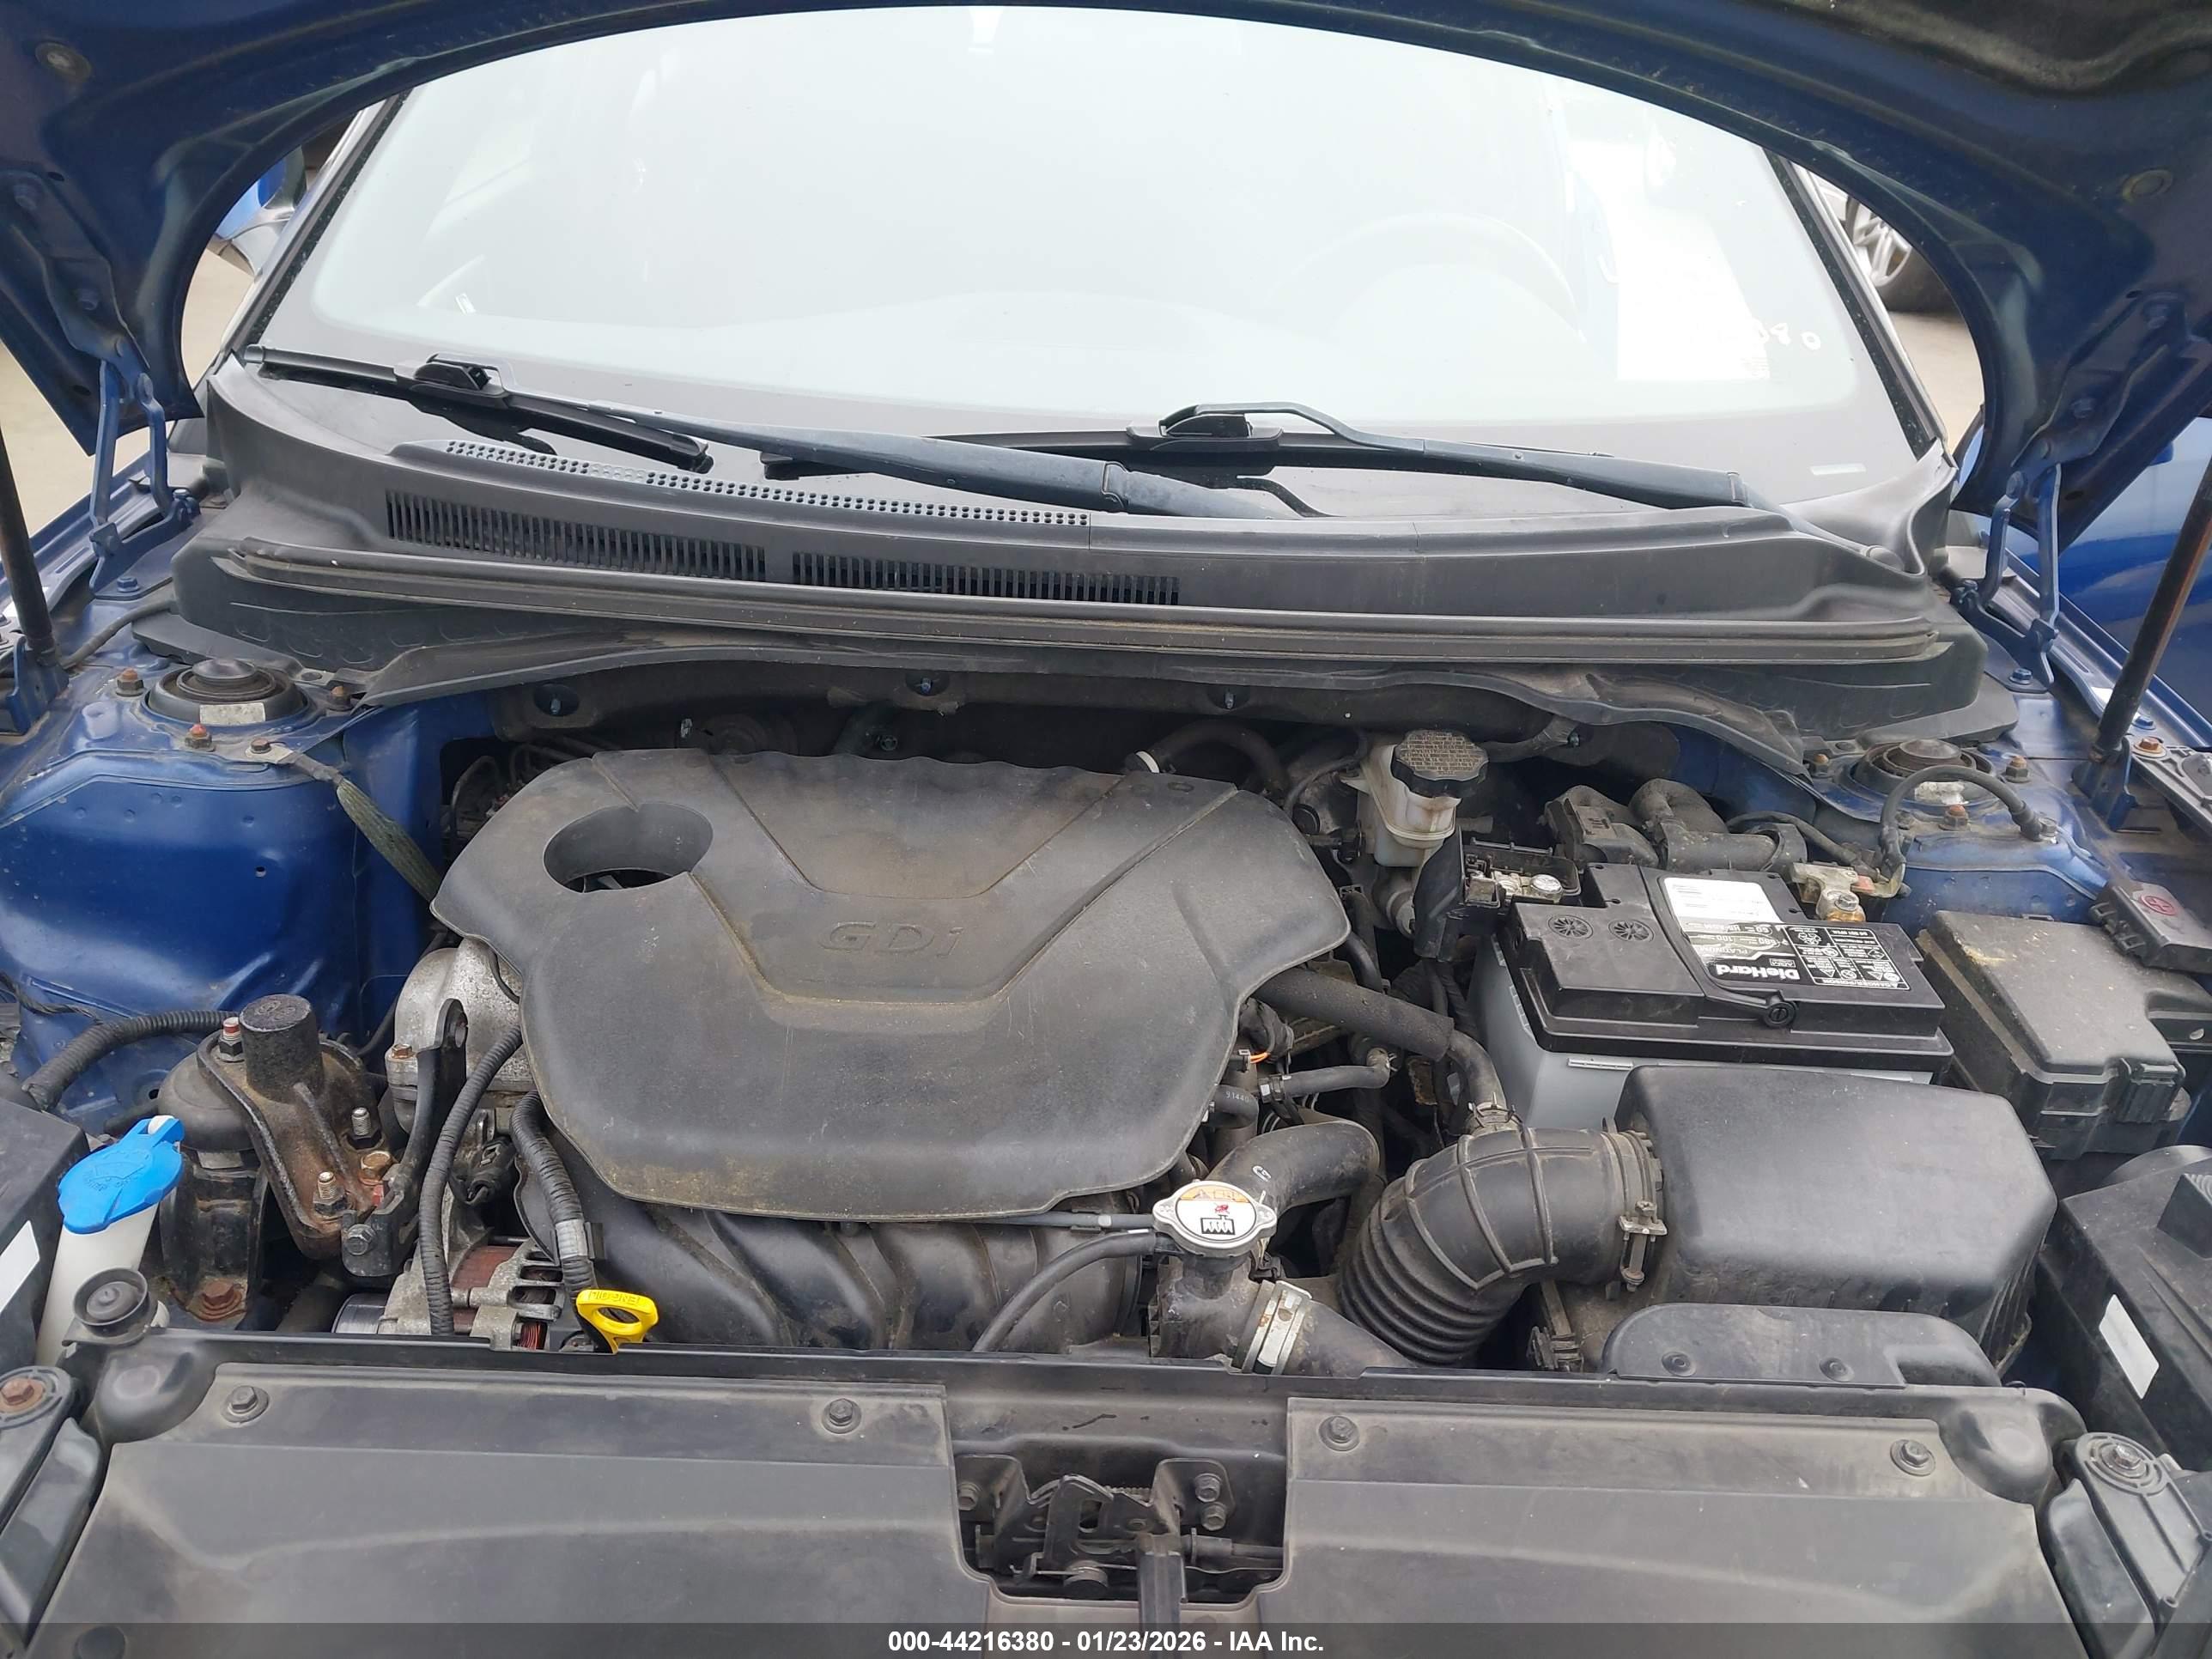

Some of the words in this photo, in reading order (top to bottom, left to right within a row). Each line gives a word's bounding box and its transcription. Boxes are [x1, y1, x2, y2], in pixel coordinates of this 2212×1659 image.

[1697, 945, 1748, 955] PLATINUM
[1716, 963, 1801, 980] DieHard
[589, 1291, 607, 1300] OIL
[612, 1293, 640, 1304] ENG
